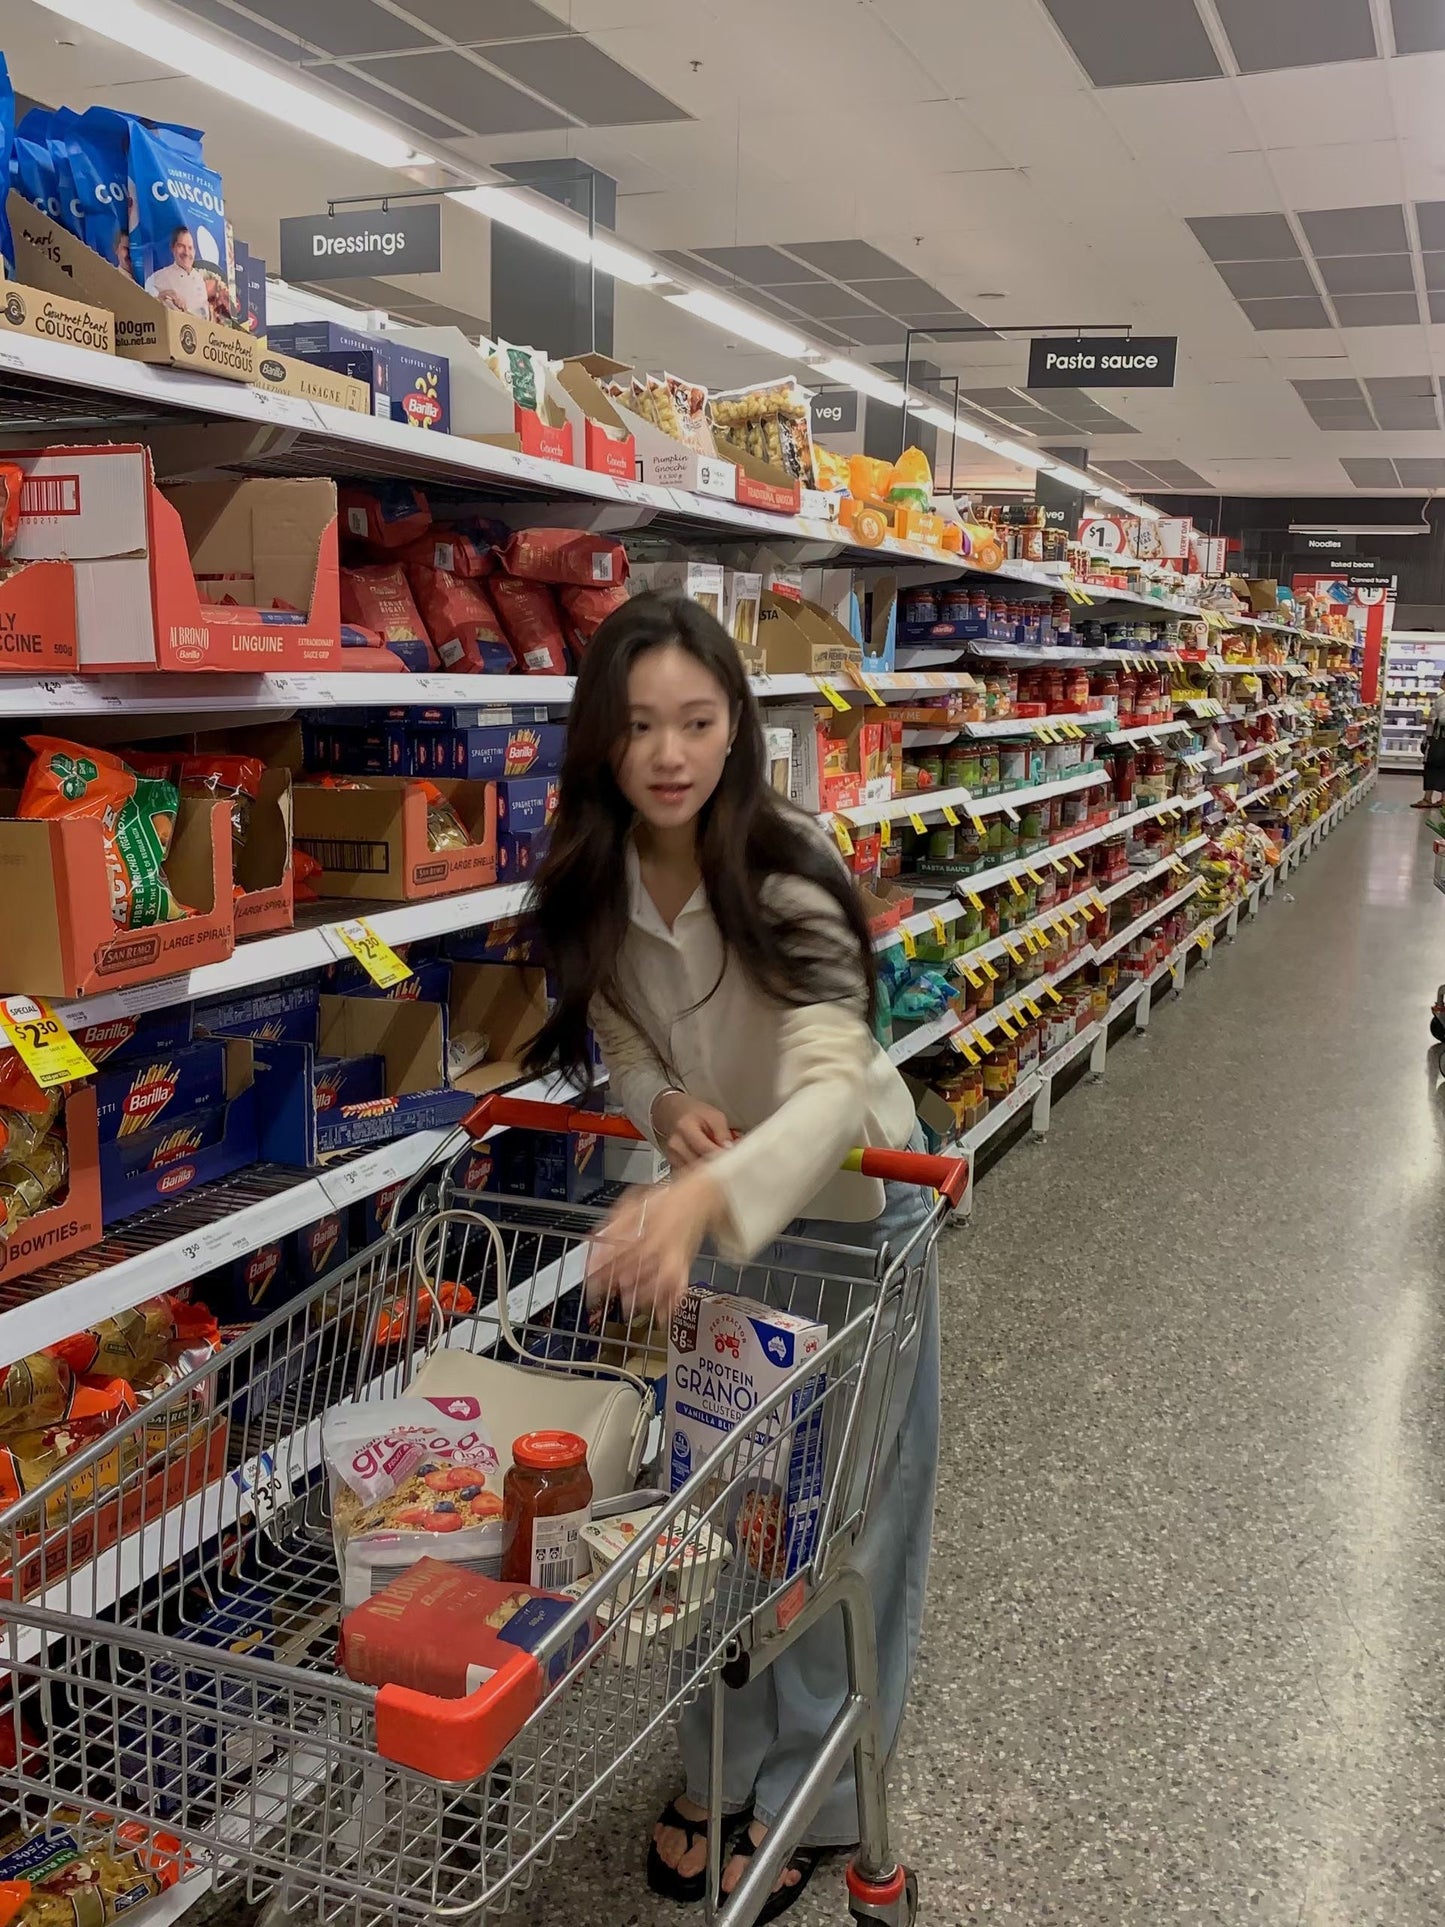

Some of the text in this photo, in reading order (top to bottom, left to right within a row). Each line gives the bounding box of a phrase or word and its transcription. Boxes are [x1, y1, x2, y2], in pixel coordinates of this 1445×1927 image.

[152, 178, 224, 216] COUSCOU
[312, 230, 405, 256] Dressings
[44, 302, 108, 333] Gourmet Pearl
[35, 317, 108, 350] COUSCOUS
[208, 332, 253, 357] Gourmet Pearl
[203, 346, 253, 373] COUSCOUS
[1046, 353, 1159, 369] Pasta sauce
[262, 363, 284, 378] Barilla
[300, 380, 341, 402] LASAGNE
[408, 398, 438, 417] Barilla
[815, 405, 842, 422] veg
[653, 453, 688, 467] Pumpkin
[1046, 510, 1065, 521] veg
[1308, 540, 1341, 548] Noodles
[759, 609, 779, 621] STA
[54, 644, 73, 656] 500g
[232, 635, 284, 652] LINGUINE
[179, 650, 200, 659] Barilla
[471, 747, 504, 757] SPAGHETTINI
[508, 746, 533, 759] Barilla
[126, 854, 144, 894] ENRICHED
[133, 897, 145, 923] FIBRE
[163, 925, 231, 951] LARGE SPIRALS
[107, 944, 151, 963] SAN REMO
[10, 1005, 38, 1016] SPECIAL
[84, 1023, 130, 1043] Barilla
[129, 1085, 169, 1112] Barilla
[161, 1170, 193, 1190] Barilla
[10, 1221, 78, 1261] BOWTIES
[312, 1224, 339, 1248] Barilla
[250, 1254, 278, 1279] Barilla
[673, 1308, 697, 1323] SUGAR
[709, 1315, 747, 1344] RED TRACTOR
[700, 1357, 753, 1387] PROTEIN
[683, 1405, 715, 1425] VANILLA
[80, 1463, 112, 1484] PATA
